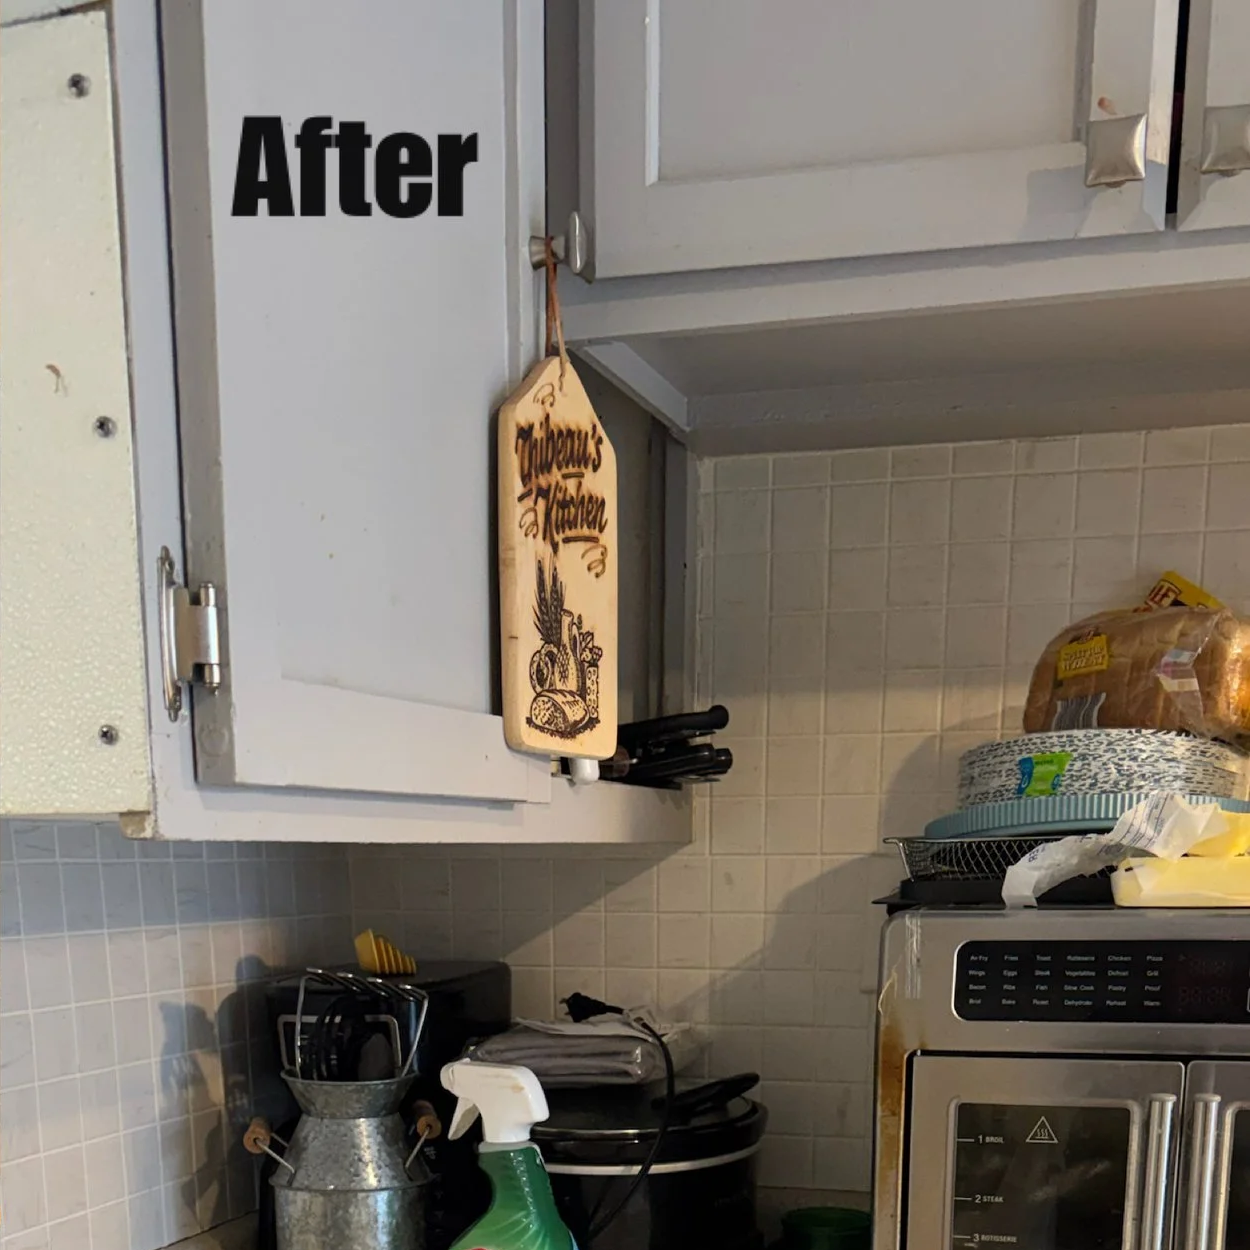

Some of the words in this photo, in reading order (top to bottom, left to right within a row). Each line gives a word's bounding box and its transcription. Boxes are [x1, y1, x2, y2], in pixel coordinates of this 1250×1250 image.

[533, 480, 608, 554] Kitchen
[978, 1135, 983, 1144] 1
[975, 1195, 981, 1203] 2
[973, 1233, 979, 1242] 3
[981, 1235, 1017, 1243] ROTISSERIE
